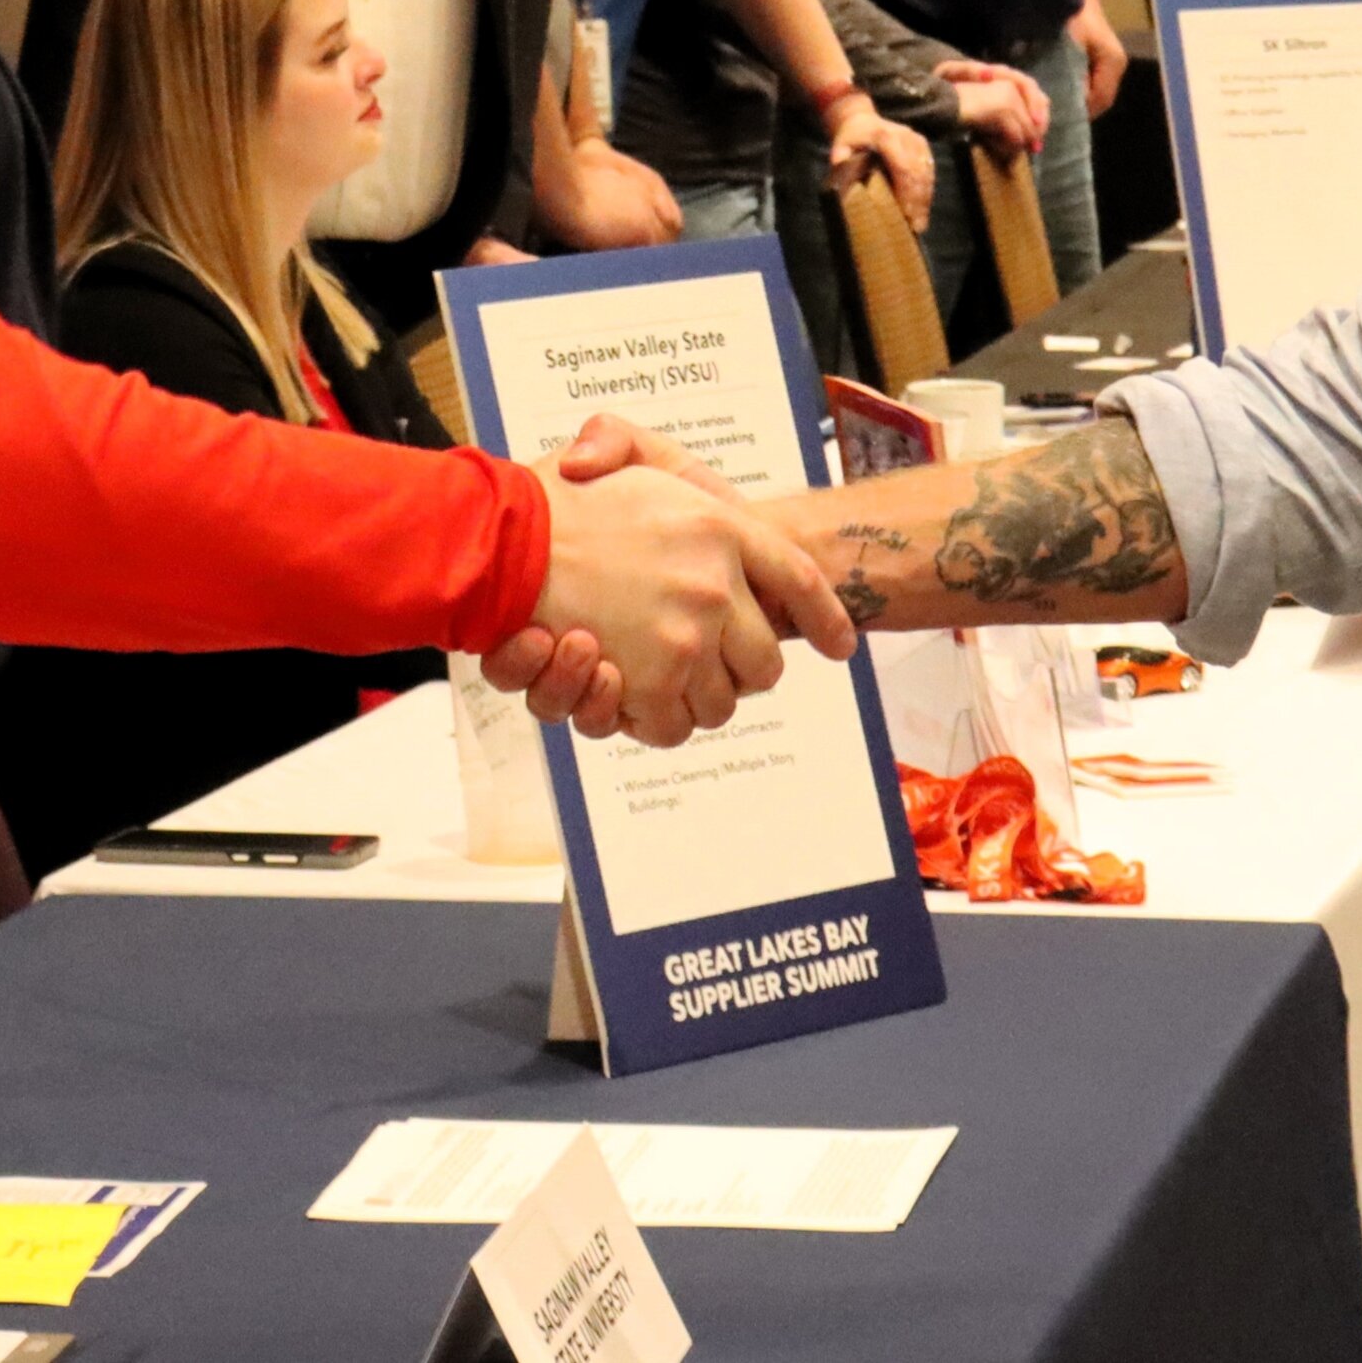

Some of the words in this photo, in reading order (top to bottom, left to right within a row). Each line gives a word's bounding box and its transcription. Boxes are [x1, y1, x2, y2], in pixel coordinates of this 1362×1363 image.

[545, 345, 621, 372] Saginaw
[624, 335, 678, 359] Valley
[682, 331, 726, 352] State
[567, 371, 656, 399] University
[661, 361, 720, 390] (SVSU)
[679, 417, 694, 432] for
[696, 414, 735, 430] various
[715, 431, 756, 448] seeking
[623, 777, 669, 793] Window
[664, 941, 743, 986] GREAT
[745, 924, 822, 969] LAKES
[822, 913, 869, 952] BAY
[669, 970, 785, 1023] SUPPLIER
[785, 948, 879, 997] SUMMIT
[534, 1264, 584, 1344] SAGINAW
[573, 1223, 615, 1288] VALLEY
[579, 1266, 635, 1352] UNIVERSITY
